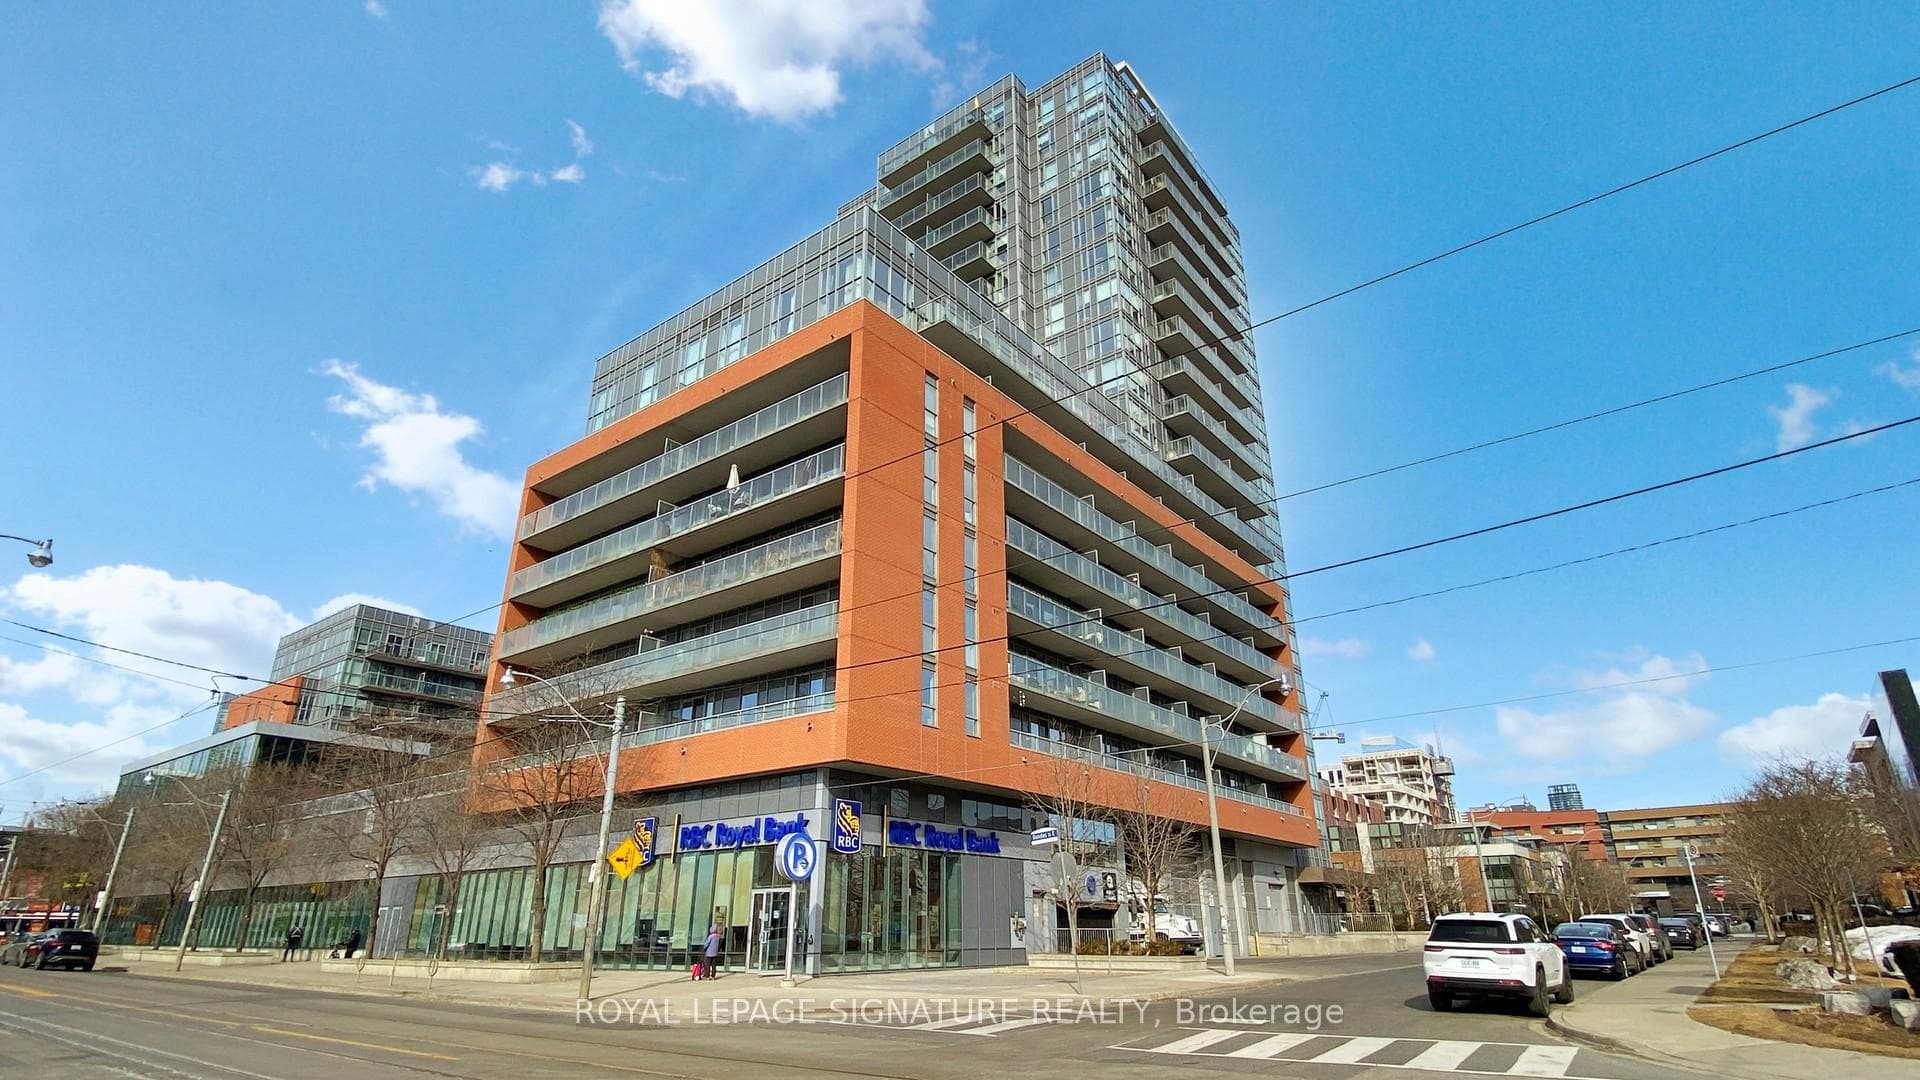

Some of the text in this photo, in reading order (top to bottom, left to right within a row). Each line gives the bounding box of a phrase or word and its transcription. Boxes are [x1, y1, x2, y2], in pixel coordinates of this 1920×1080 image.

[680, 813, 809, 850] RBC Royal Bank
[838, 836, 858, 848] RBC
[889, 821, 1000, 853] RBC Royal Bank
